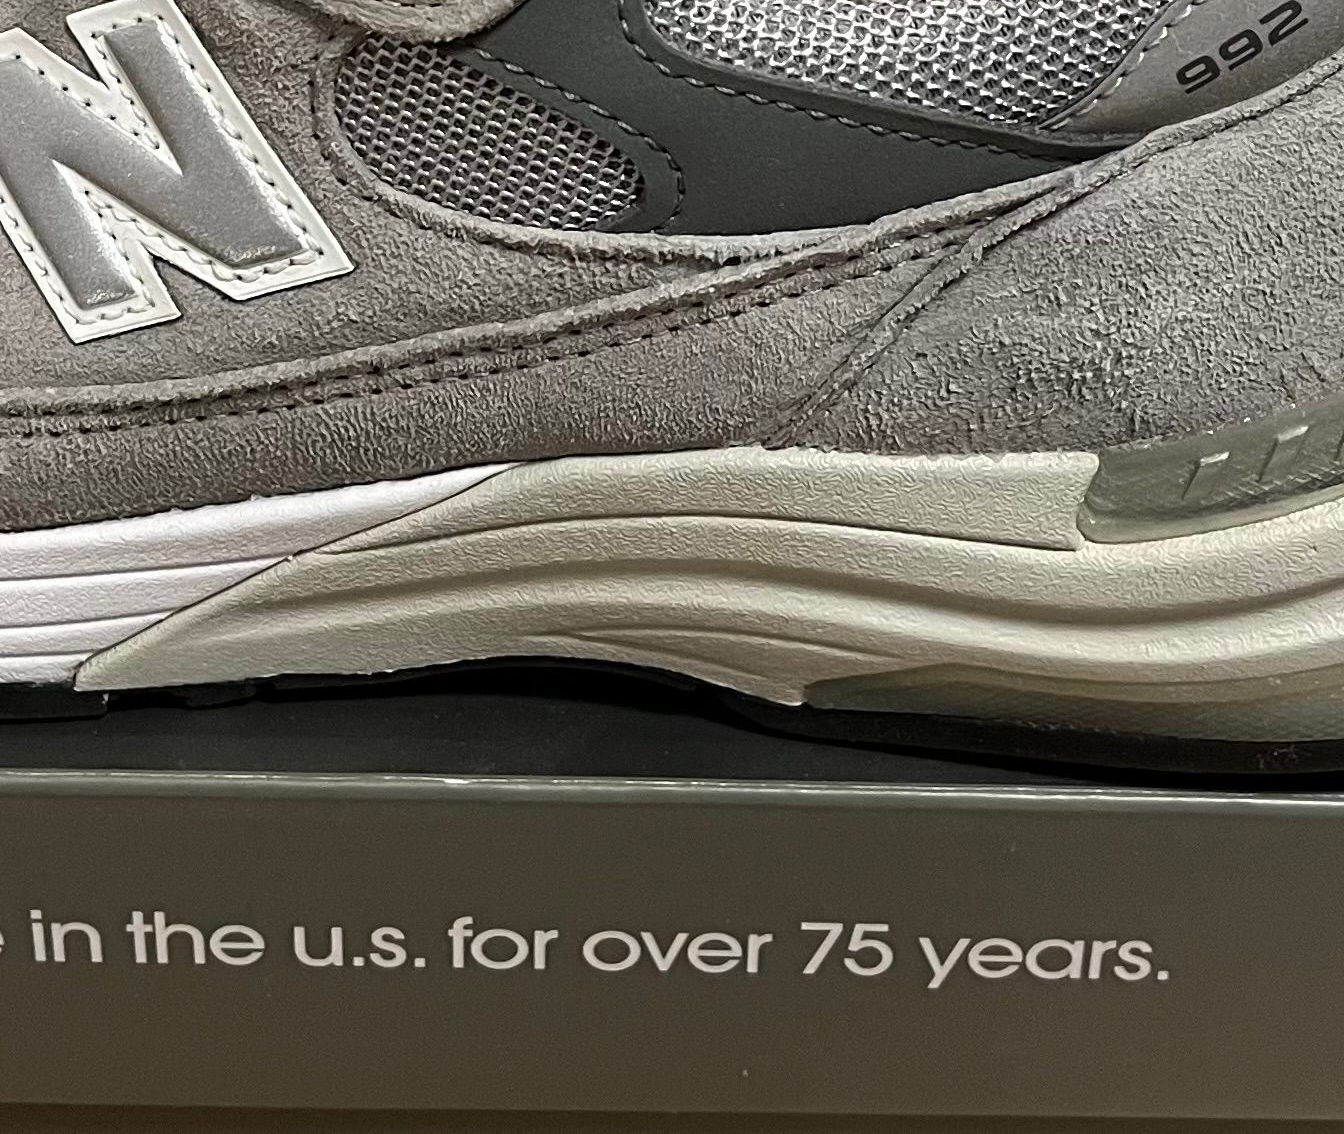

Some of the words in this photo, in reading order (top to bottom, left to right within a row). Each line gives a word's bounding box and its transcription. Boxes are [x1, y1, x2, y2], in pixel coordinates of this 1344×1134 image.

[29, 908, 104, 964] in
[125, 909, 266, 966] the
[292, 925, 427, 969] u.s.
[447, 915, 560, 971] for
[581, 929, 774, 975] over
[799, 920, 895, 977] 75
[917, 936, 1170, 990] years.
